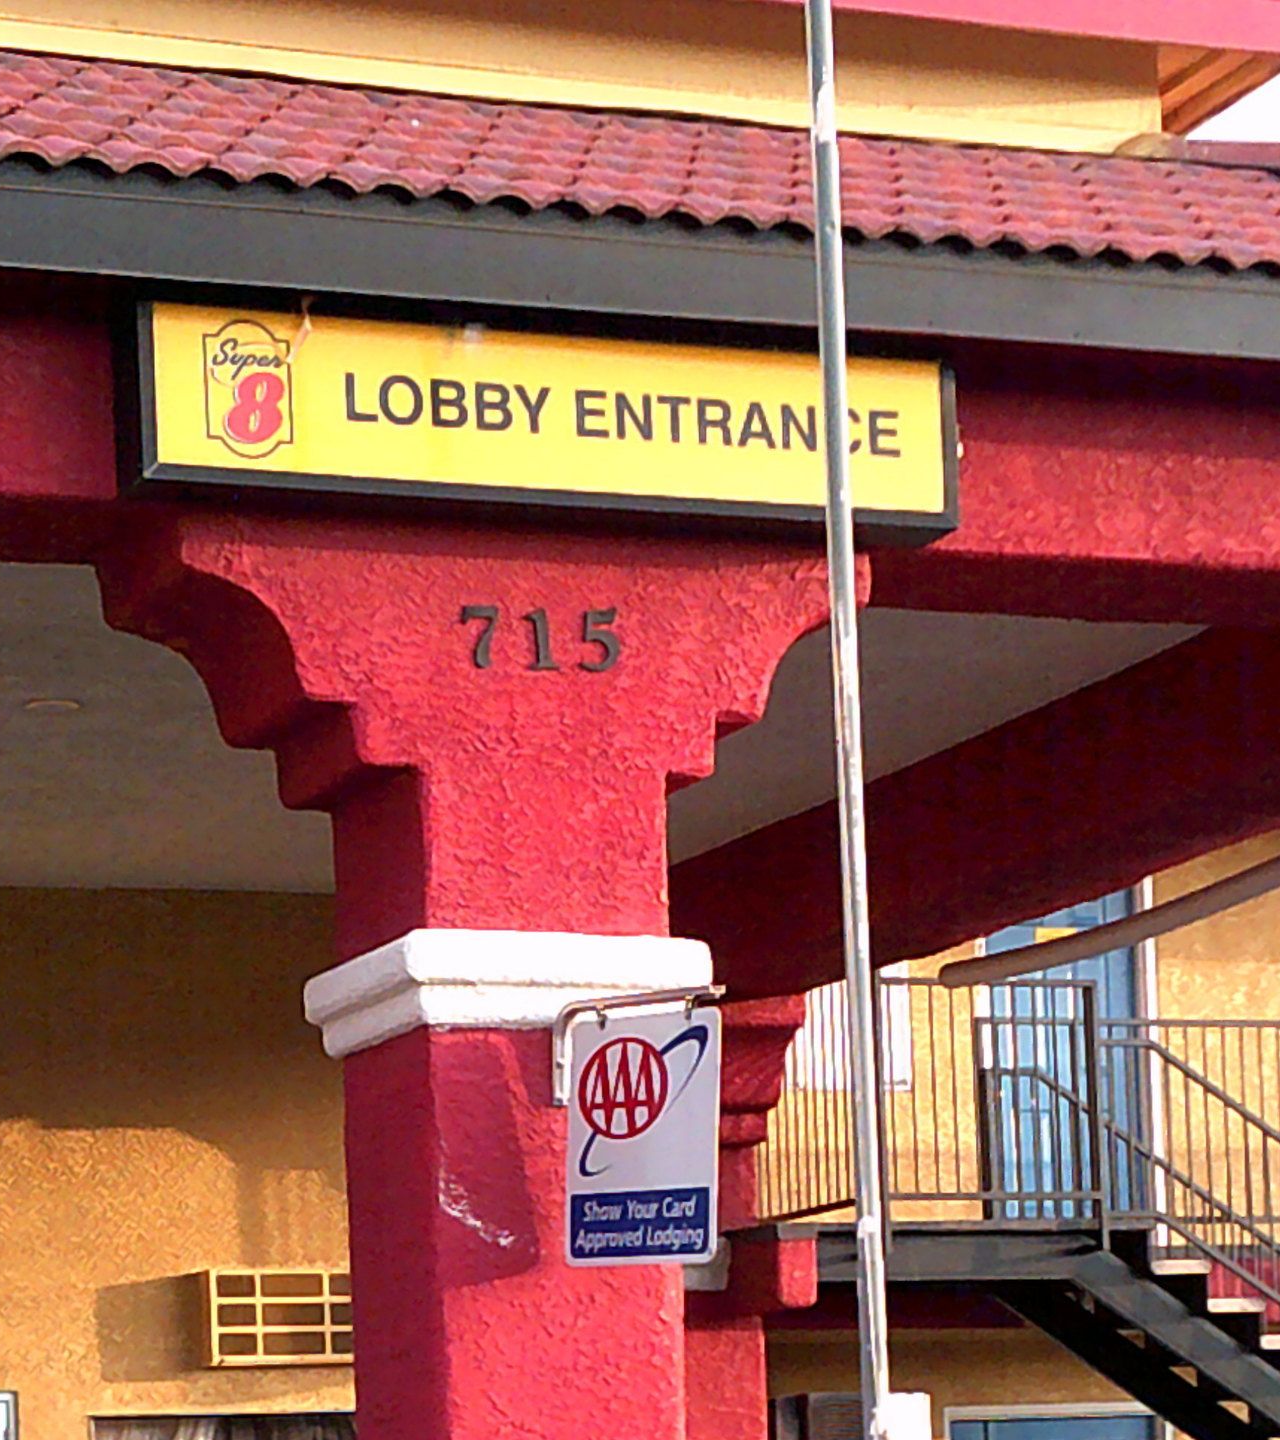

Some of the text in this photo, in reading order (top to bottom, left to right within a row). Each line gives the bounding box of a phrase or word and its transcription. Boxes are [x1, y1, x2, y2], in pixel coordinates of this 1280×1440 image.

[212, 338, 286, 380] Super
[223, 372, 285, 444] 8
[345, 372, 551, 434] LOBBY
[459, 605, 621, 672] 715
[581, 1038, 664, 1136] AAA
[575, 1225, 704, 1253] Approved Lodging
[583, 1196, 696, 1222] Show Your Card
